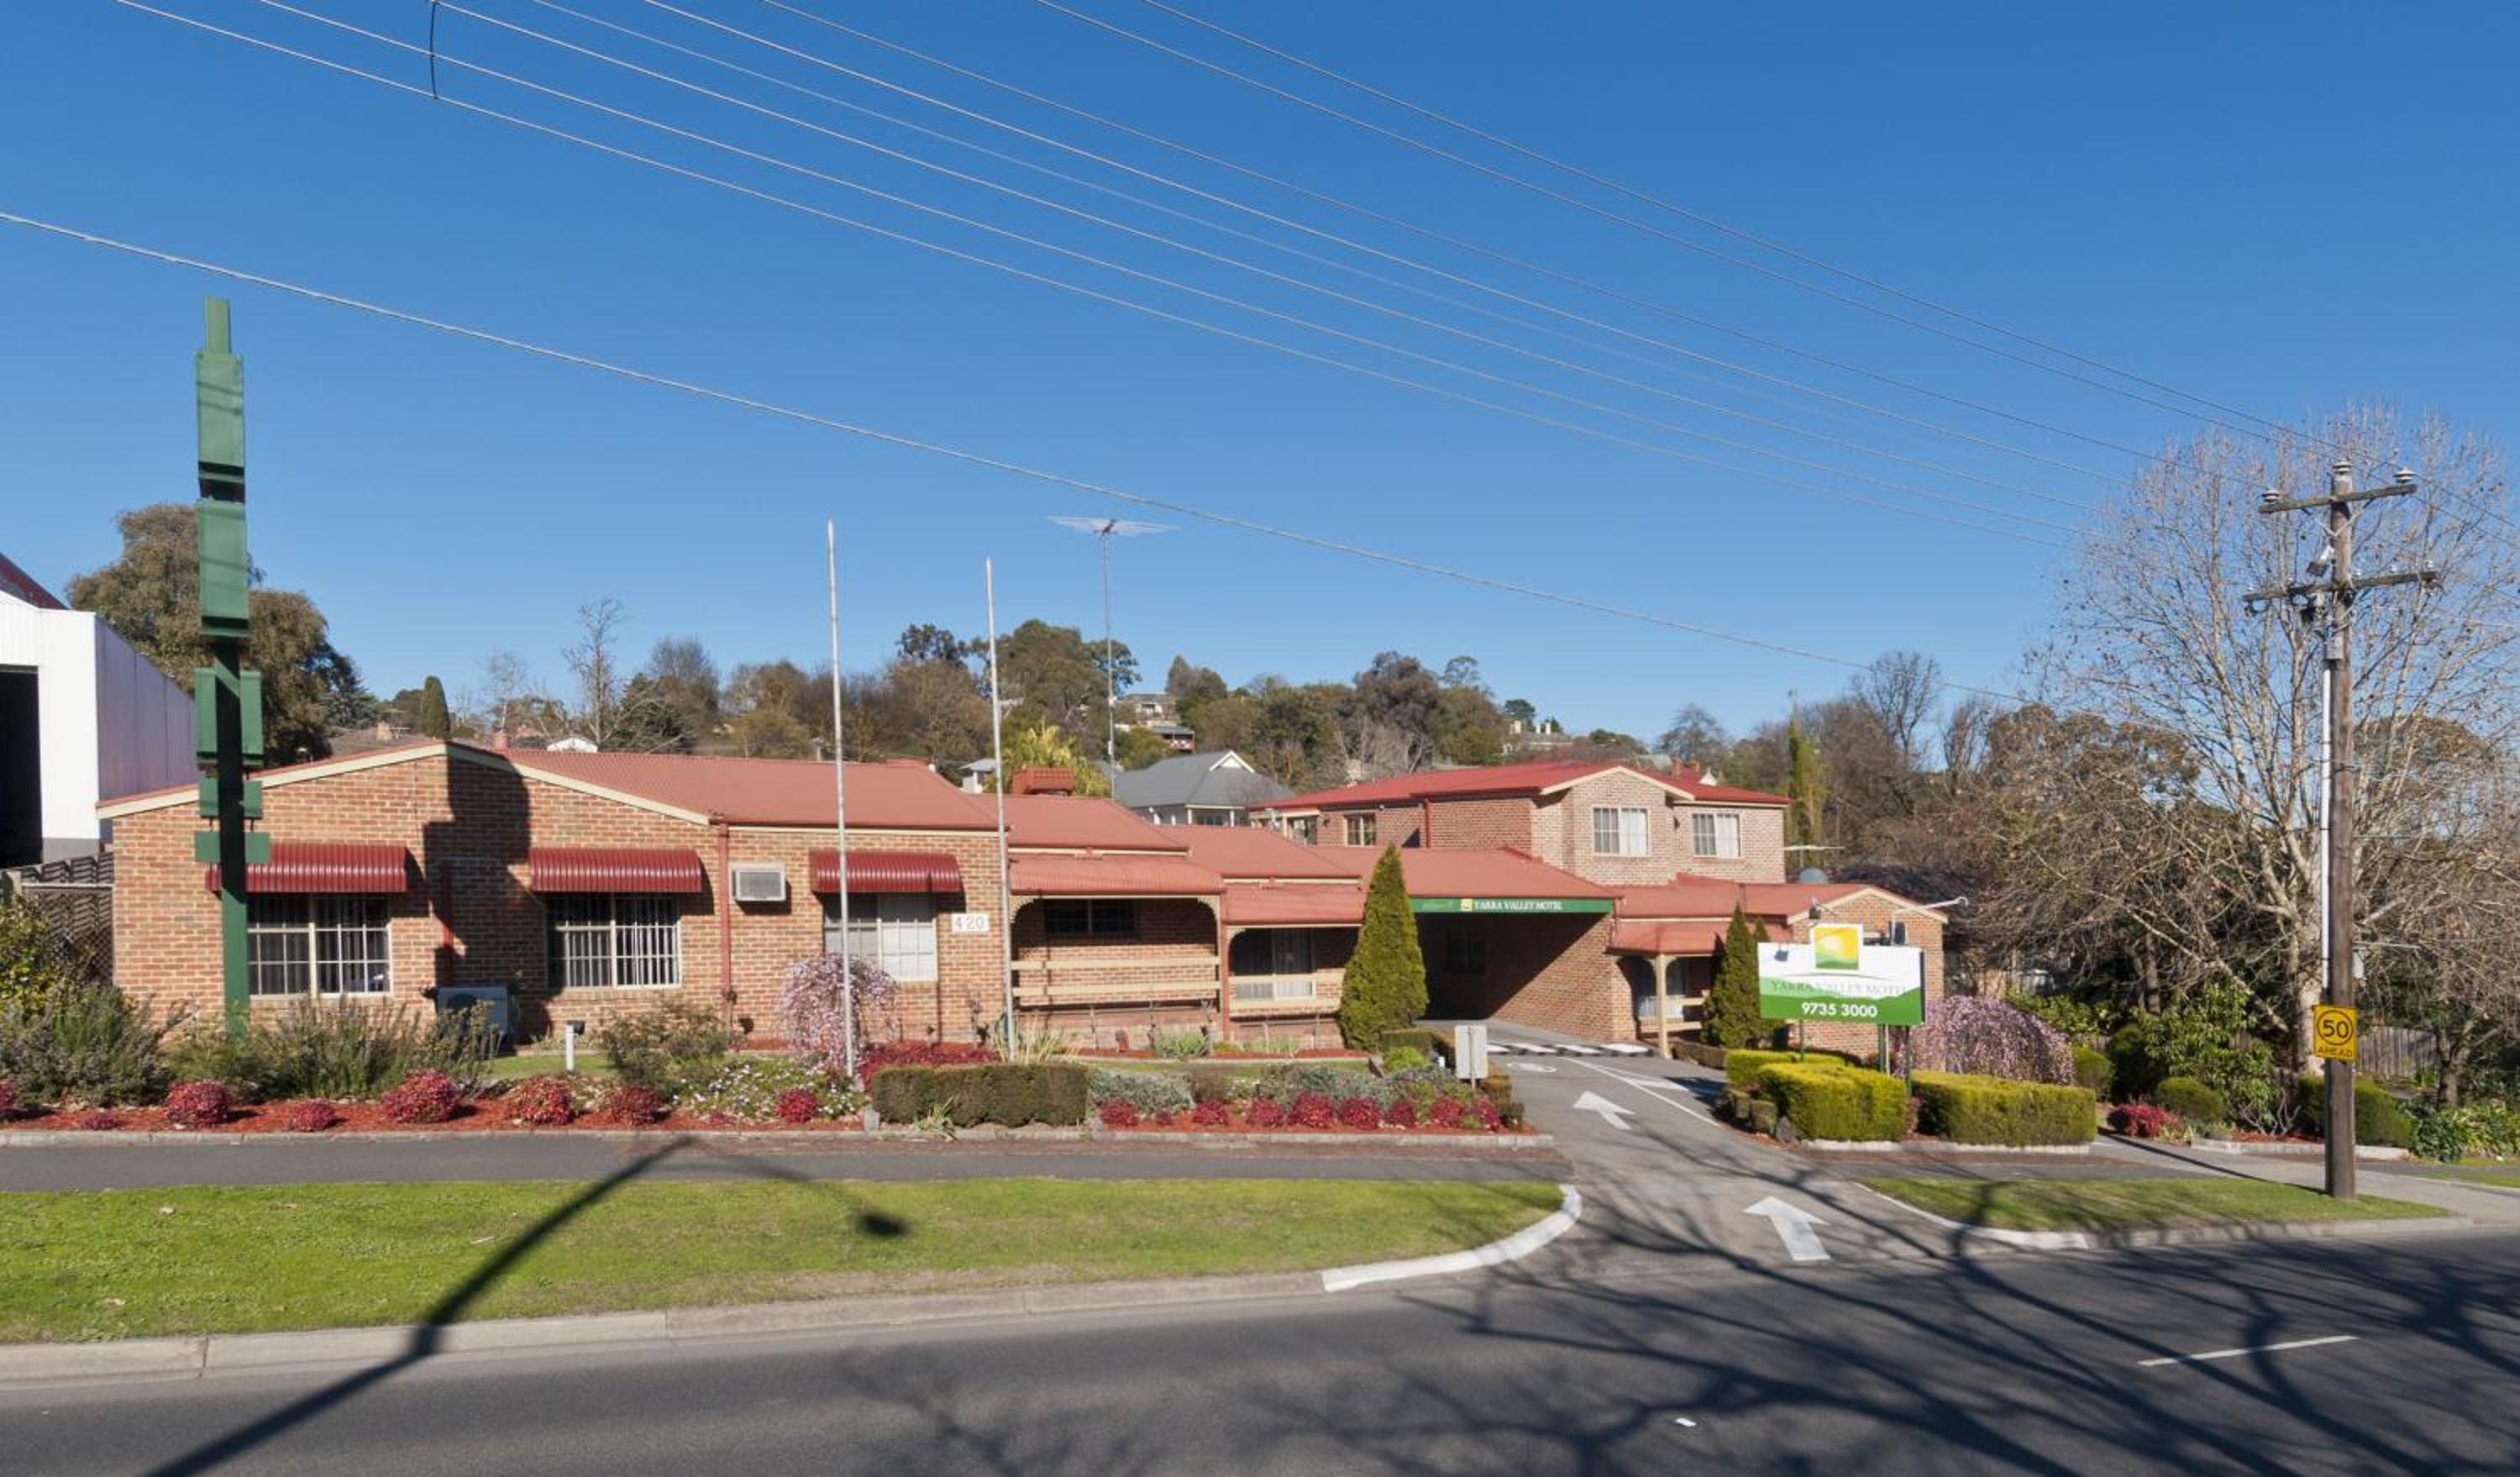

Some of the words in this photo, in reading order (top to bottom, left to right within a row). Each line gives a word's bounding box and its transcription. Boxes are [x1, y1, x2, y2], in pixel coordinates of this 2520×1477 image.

[1474, 900, 1503, 910] YARRA
[1504, 900, 1534, 910] VALLEY
[1535, 900, 1561, 910] MOTEL
[955, 915, 985, 929] 420
[1772, 980, 1814, 992] YARRA
[1816, 981, 1862, 994] VALLEY
[1866, 983, 1910, 996] MOTEL
[1801, 1002, 1837, 1016] 9735
[1841, 1004, 1877, 1018] 3000
[2323, 1019, 2349, 1038] 50
[2318, 1046, 2353, 1058] AHEAD
